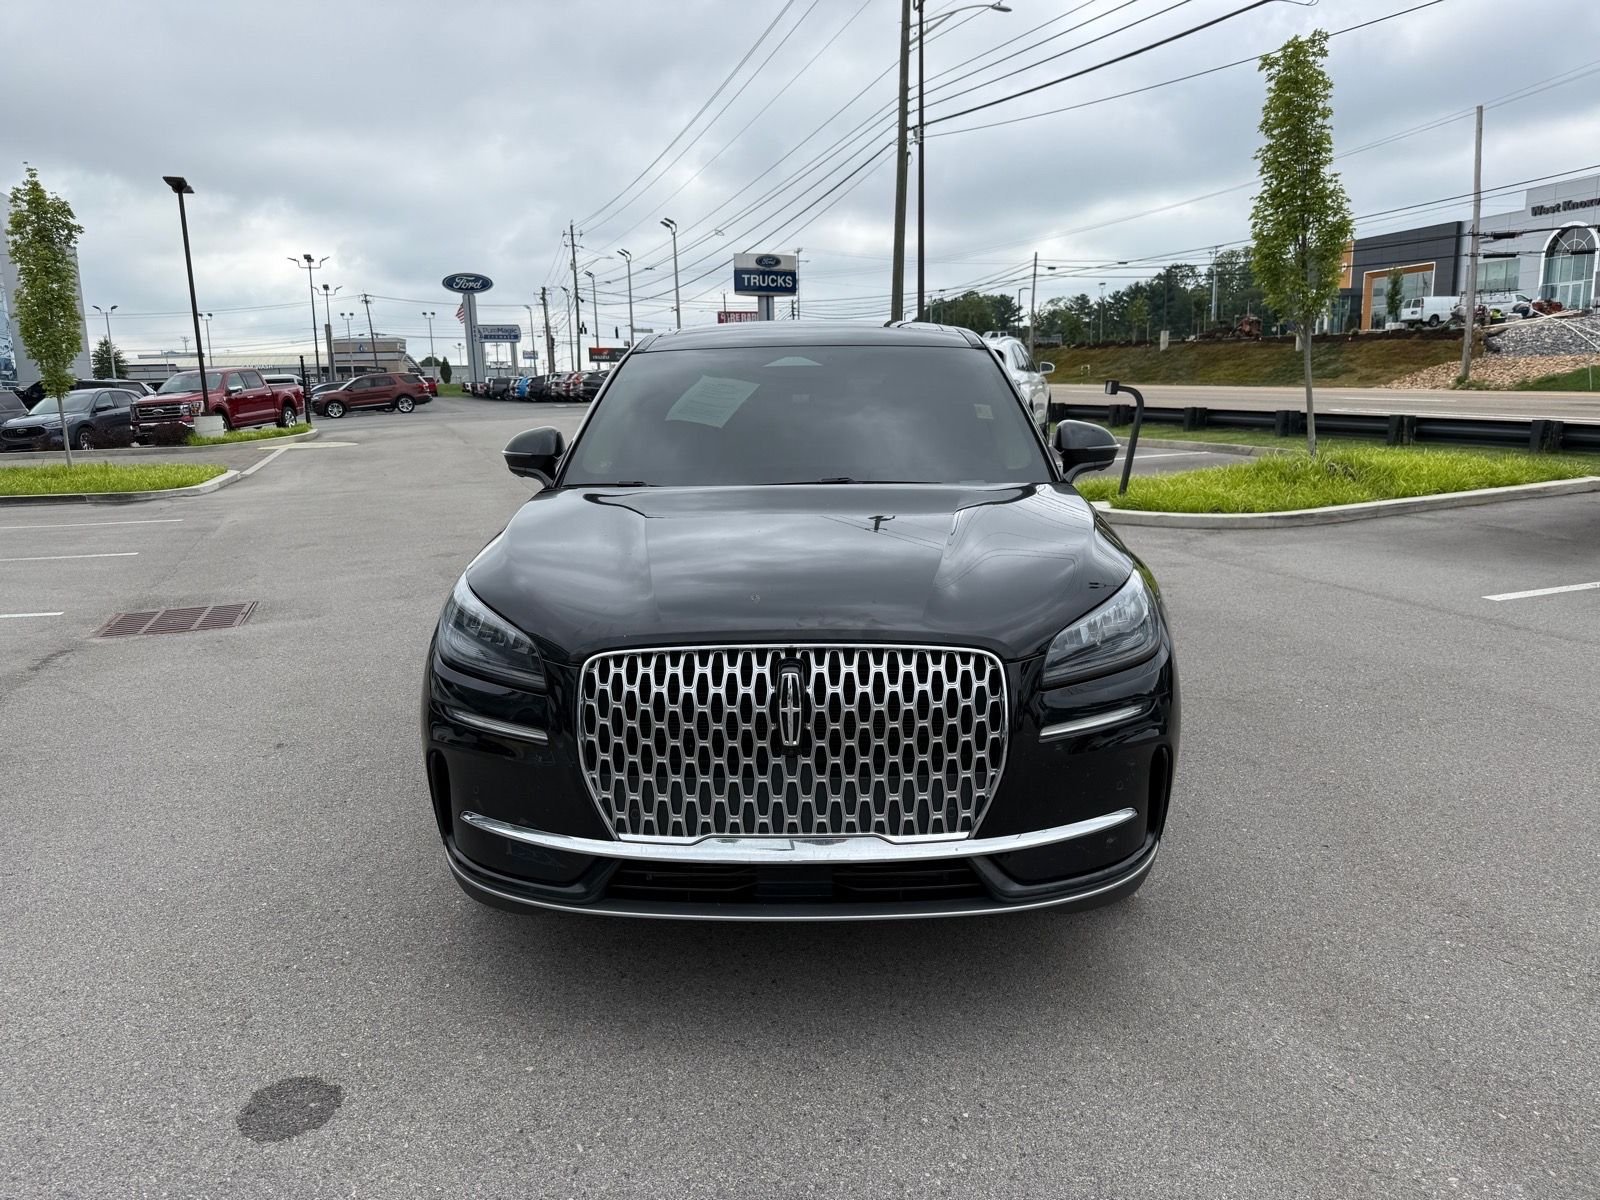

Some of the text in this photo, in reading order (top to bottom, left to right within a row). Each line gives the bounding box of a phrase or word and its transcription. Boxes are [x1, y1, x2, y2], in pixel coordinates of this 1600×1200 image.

[1531, 203, 1561, 216] West
[453, 276, 482, 289] Ford
[742, 274, 793, 288] TRUCKS
